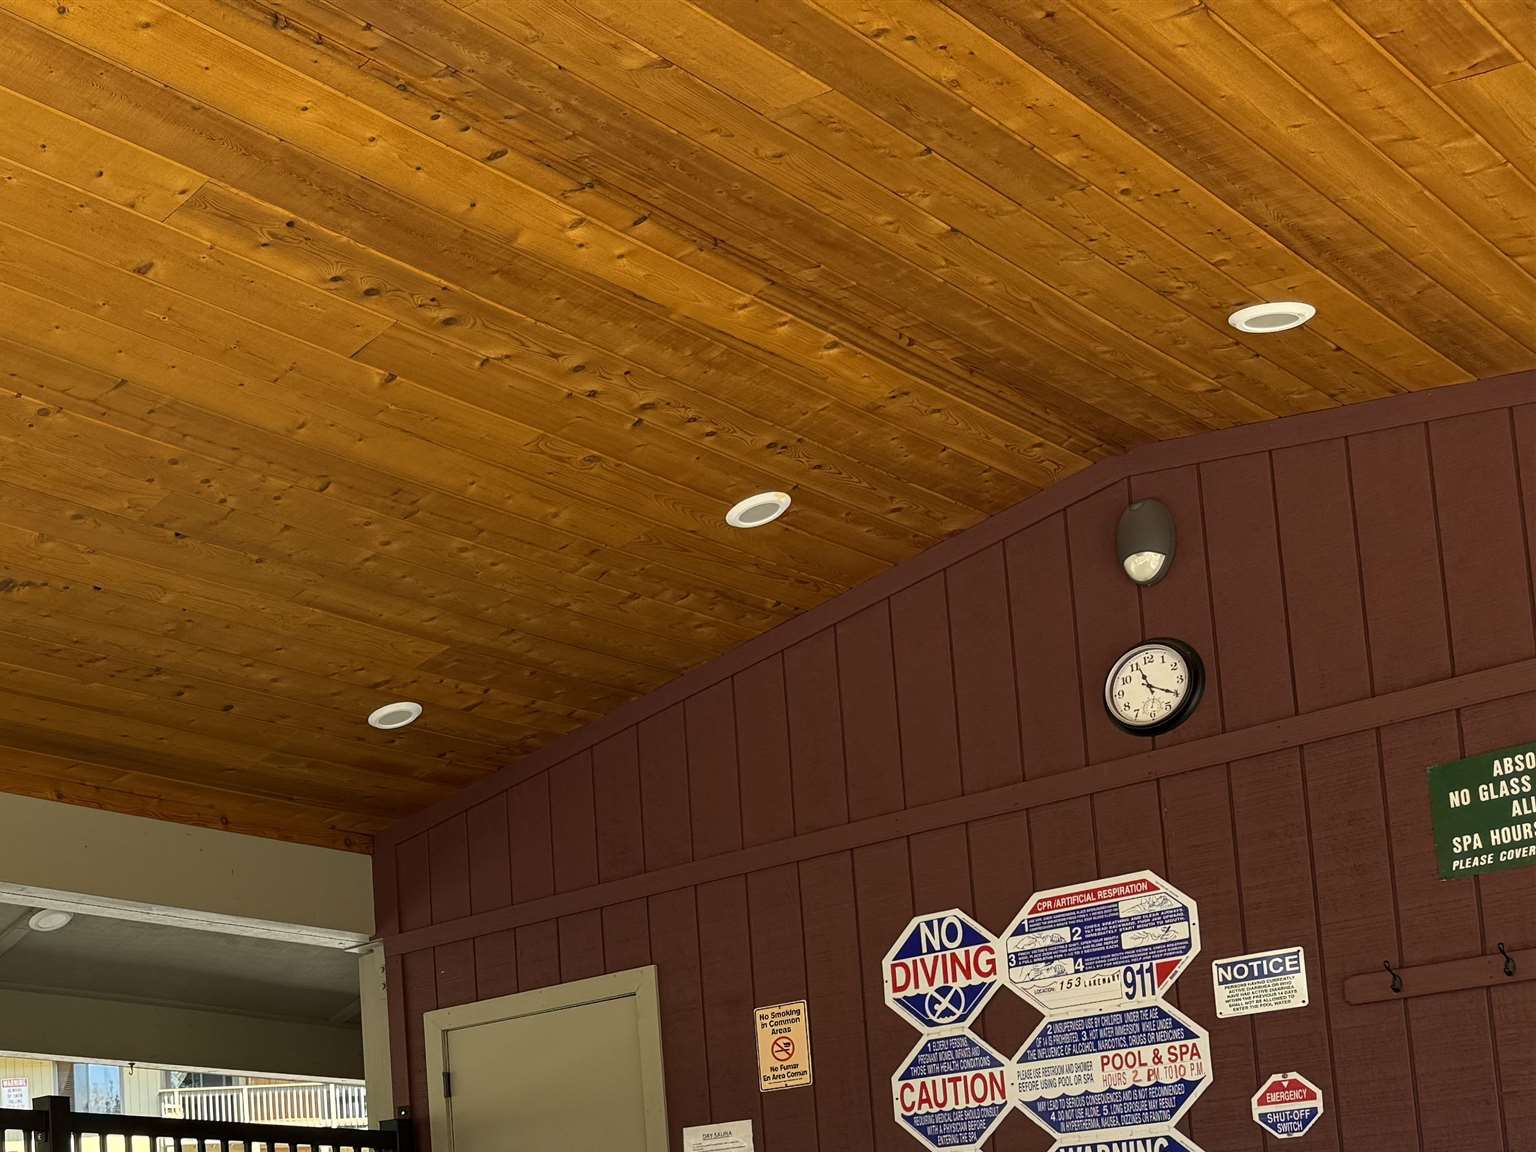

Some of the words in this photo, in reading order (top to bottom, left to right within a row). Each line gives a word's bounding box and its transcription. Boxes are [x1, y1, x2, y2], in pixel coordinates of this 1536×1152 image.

[1143, 655, 1154, 665] 12
[1161, 656, 1165, 664] 1
[1171, 662, 1178, 671] 2
[1130, 662, 1139, 672] 11
[1122, 675, 1131, 685] 10
[1177, 675, 1184, 684] 3
[1118, 690, 1124, 699] 9
[1124, 702, 1130, 711] 8
[1165, 701, 1171, 711] 5
[1134, 709, 1140, 720] 7
[1150, 710, 1156, 718] 6
[1449, 788, 1471, 808] NO
[1478, 775, 1532, 802] GLASS
[1452, 833, 1482, 854] SPA
[1452, 854, 1494, 871] PLEASE
[1037, 899, 1053, 911] CPR
[1098, 882, 1148, 899] RESPIRATION
[1022, 920, 1029, 932] 1
[920, 916, 963, 953] NO
[1072, 927, 1081, 940] 2
[1009, 954, 1016, 966] 3
[1074, 958, 1084, 971] 4
[890, 945, 996, 993] DIVING
[1218, 955, 1299, 982] NOTICE
[1060, 977, 1081, 990] 153
[1123, 962, 1156, 999] 911
[771, 1009, 800, 1019] Smoking
[769, 1017, 800, 1027] Common
[1047, 1024, 1052, 1034] 2
[1053, 1019, 1084, 1034] UNSUPERVISED
[1085, 1018, 1094, 1029] USE
[1101, 1013, 1122, 1026] CHILDREN
[1125, 1011, 1139, 1023] UNDER
[1140, 1009, 1149, 1021] THE
[1149, 1008, 1159, 1020] AGE
[772, 1027, 791, 1035] Areas
[1036, 1037, 1042, 1047] OF
[1100, 1027, 1114, 1039] WATER
[1115, 1023, 1140, 1036] IMMERSION
[1142, 1021, 1156, 1032] WHILE
[1157, 1018, 1172, 1031] UNDER
[928, 1043, 931, 1052] 1
[1027, 1049, 1037, 1060] THE
[1037, 1046, 1064, 1059] INFLUENCE
[1064, 1045, 1072, 1055] OF
[1129, 1034, 1146, 1046] DRUGS
[1148, 1032, 1155, 1043] OR
[1156, 1028, 1184, 1042] MEDICINES
[1100, 1050, 1147, 1072] POOL
[1152, 1048, 1163, 1065] &
[1168, 1043, 1201, 1063] SPA
[911, 1065, 926, 1076] THOSE
[927, 1063, 939, 1074] WITH
[941, 1060, 959, 1073] HEALTH
[960, 1056, 991, 1070] CONDITIONS
[1017, 1069, 1032, 1080] PLEASE
[1033, 1068, 1041, 1079] USE
[1042, 1064, 1065, 1077] RESTROOM
[1065, 1063, 1074, 1075] AND
[1075, 1061, 1093, 1073] SHOWER
[1018, 1080, 1039, 1092] BEFORE
[1040, 1078, 1057, 1090] USING
[1058, 1076, 1073, 1087] POOL
[1074, 1075, 1083, 1086] OR
[1084, 1073, 1094, 1084] SPA
[1103, 1072, 1127, 1087] HOURS
[1132, 1070, 1142, 1082] 2
[900, 1070, 1006, 1112] CAUTION
[1066, 1096, 1085, 1108] SERIOUS
[1086, 1092, 1122, 1106] CONSEQUENCES
[1149, 1084, 1184, 1098] RECOMMENDED
[1266, 1089, 1307, 1102] EMERGENCY
[1124, 1100, 1148, 1112] EXPOSURE
[927, 1124, 939, 1135] WITH
[943, 1121, 968, 1133] PHYSICIAN
[1277, 1122, 1303, 1133] SWITCH
[938, 1134, 959, 1145] ENTERING
[960, 1133, 968, 1143] THE
